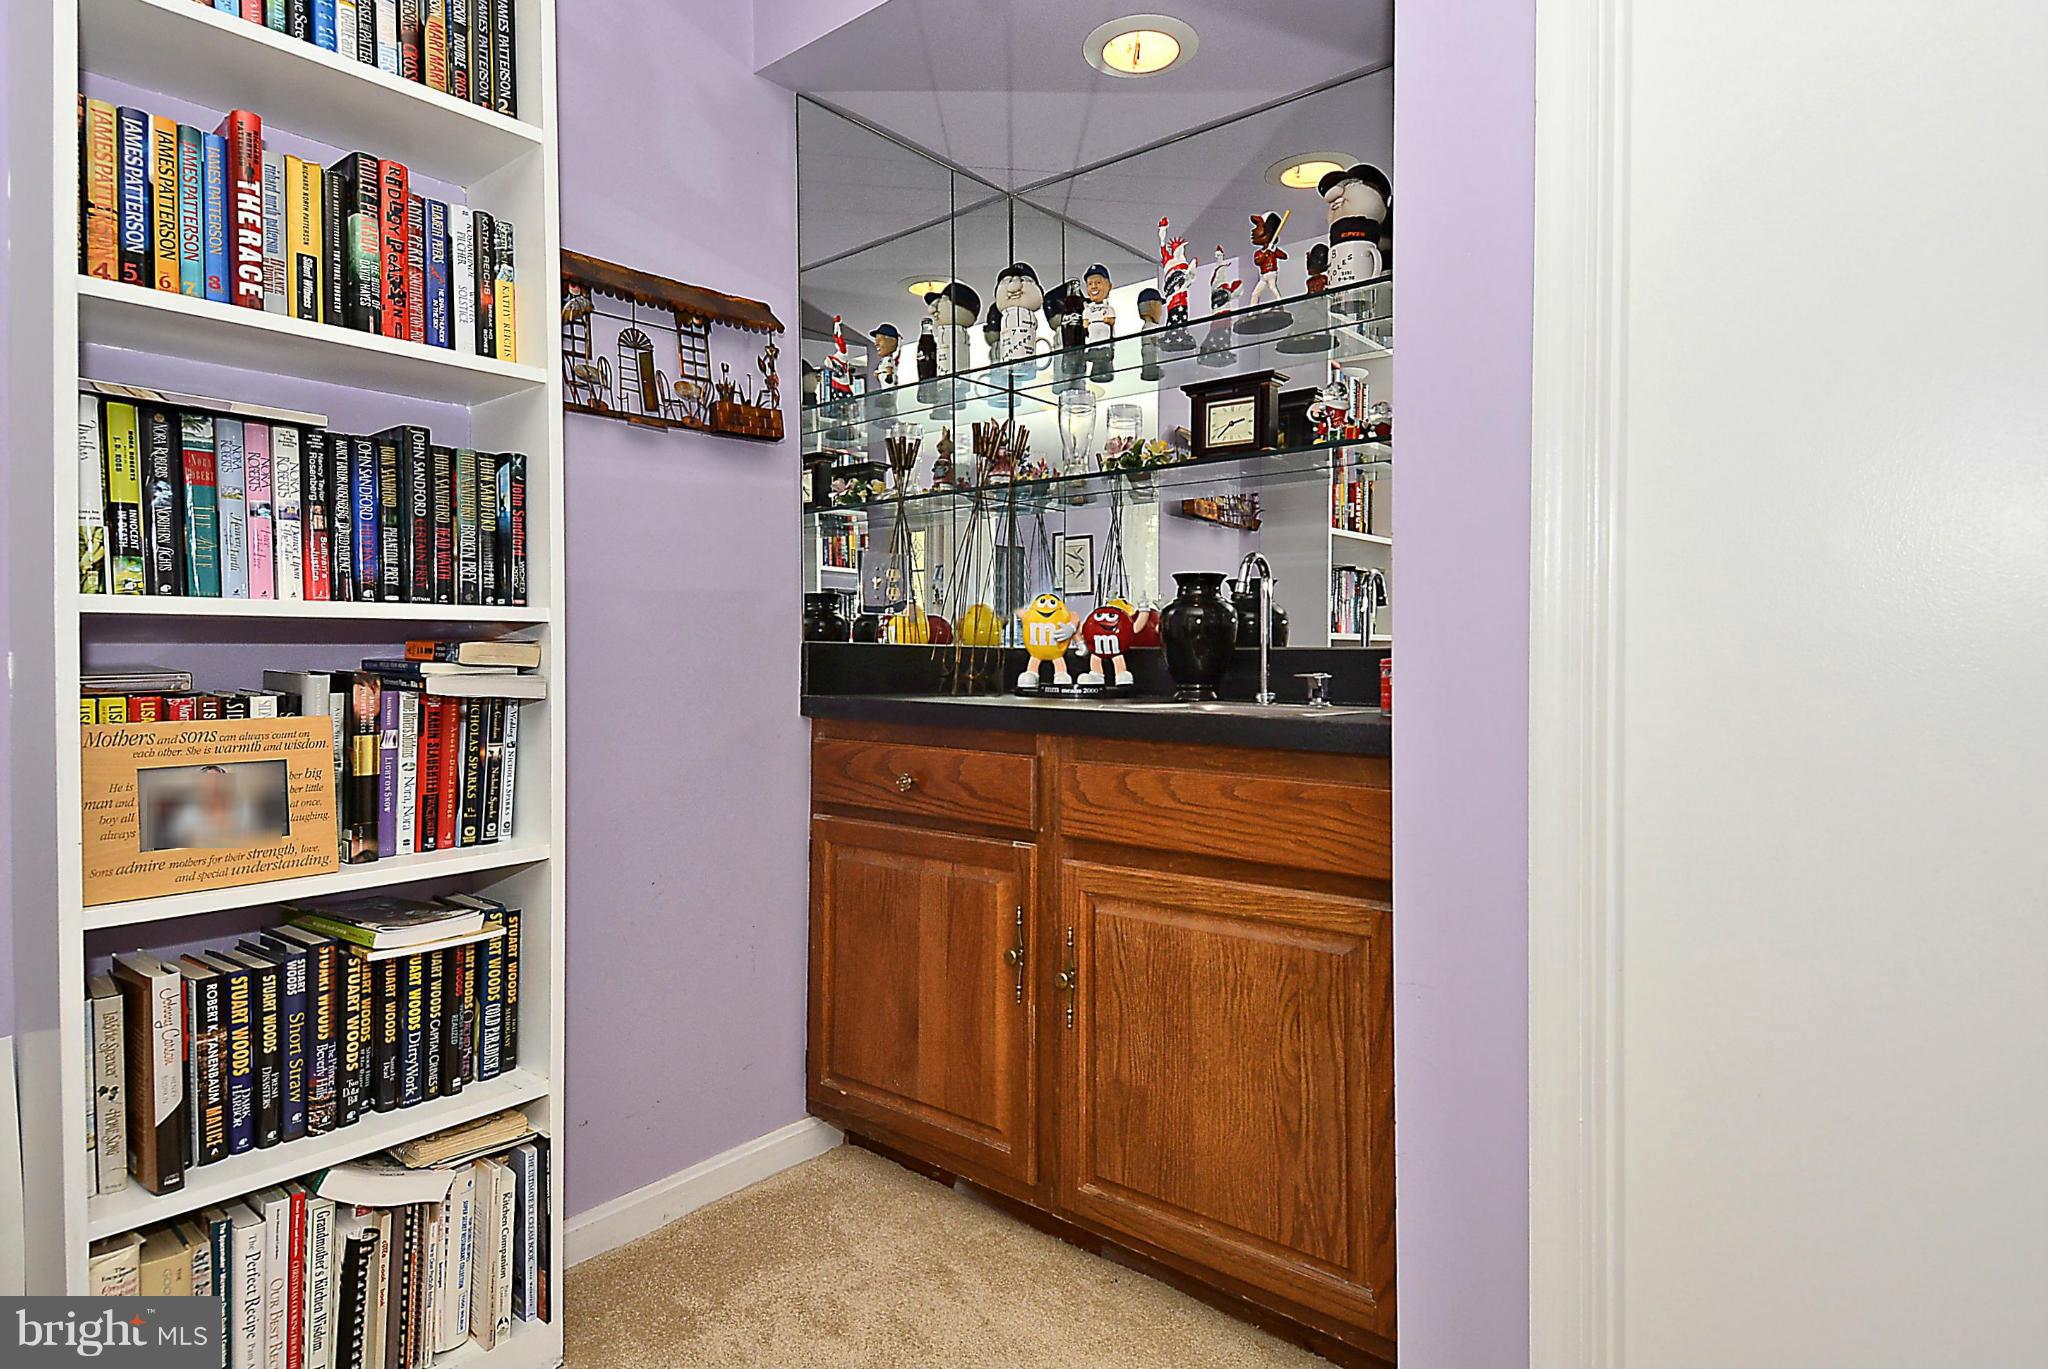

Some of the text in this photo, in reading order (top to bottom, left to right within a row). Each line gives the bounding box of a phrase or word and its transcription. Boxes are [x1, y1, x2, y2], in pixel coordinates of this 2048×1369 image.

[429, 22, 446, 90] MARY MARY
[453, 33, 466, 72] DOUBLE
[478, 36, 489, 99] PATTERSON
[498, 34, 511, 99] PATTERSON
[91, 108, 115, 260] JAMES PATTERSON
[207, 147, 220, 184] JAMES
[122, 117, 144, 282] JAMES PATTERSON 5
[156, 129, 176, 288] JAMES PATTERSON 6
[181, 141, 199, 262] JAMES PATTERSON
[209, 185, 222, 254] PATTERSON
[265, 164, 284, 254] richard north patterson
[360, 158, 379, 254] RIDLEY PEARSON
[237, 180, 263, 300] THE RACE
[408, 199, 423, 270] ANNE PERRY
[302, 256, 313, 308] Silent Witness
[360, 259, 370, 307] DAVID HAYES
[370, 277, 380, 309] BODY OF
[488, 329, 493, 340] NO
[502, 285, 511, 357] KATHY REICHS
[150, 424, 168, 478] NORA ROBERTS
[221, 440, 232, 473] ROBERTS
[232, 445, 242, 470] NORA
[248, 452, 260, 491] ROBERTS
[261, 458, 270, 488] NORA
[277, 457, 289, 498] ROBERTS
[309, 452, 317, 501] Rosenberg
[411, 430, 426, 516] JOHN SANDFORD
[290, 462, 299, 495] NORA
[355, 440, 372, 520] JOHN SANDFORD
[434, 454, 449, 523] JOHN SANDFORD
[479, 457, 495, 531] JOHN SANDFORD
[129, 509, 139, 549] INNOCENT
[157, 506, 174, 571] NORTHERN LIGHTS
[512, 482, 524, 556] John Sandford
[383, 527, 398, 586] PHANTOM PREY
[438, 528, 451, 580] DEAD WATCH
[461, 525, 476, 583] BROKEN PREY
[1094, 635, 1120, 654] m
[84, 729, 156, 748] Mothers
[157, 734, 178, 745] and
[179, 730, 217, 744] sons
[219, 734, 238, 742] can
[239, 733, 269, 743] always
[272, 731, 297, 740] count
[133, 738, 329, 758] each other. She is warmth and wisdom.
[493, 711, 501, 738] Guardian
[304, 768, 322, 781] big
[385, 757, 393, 780] LIGHT
[467, 756, 478, 799] SPARKS
[504, 711, 516, 816] Wedding NICHOLAS SPARKS
[84, 799, 113, 810] man
[402, 777, 414, 831] Nora, Nora
[116, 844, 298, 877] admire strength,
[231, 854, 333, 876] understanding.
[287, 960, 297, 995] WOODS
[297, 959, 306, 992] STUART
[507, 916, 517, 1004] STUART WOODS
[231, 976, 249, 1077] STUART WOODS
[263, 975, 277, 1053] STUART WOODS
[346, 958, 360, 1071] STUART WOODS
[408, 988, 421, 1030] WOODS
[207, 983, 220, 1104] ROBERT K. TANENBAUM
[289, 1012, 304, 1102] Short Straw
[428, 1020, 440, 1087] CAPITAL CRIMES
[483, 1003, 500, 1073] COLD PARADISE
[206, 1106, 222, 1148] MALICE
[232, 1085, 242, 1127] HARBOR
[241, 1088, 250, 1118] DARK
[527, 1168, 535, 1202] ULTIMATE
[527, 1204, 535, 1215] ICE
[499, 1192, 512, 1279] Kitchen Companion
[527, 1216, 535, 1241] CREAM
[527, 1242, 535, 1262] BOOK
[242, 1252, 261, 1339] Perfect Recipe
[312, 1210, 330, 1352] Grandmother's Kitchen Wisdom
